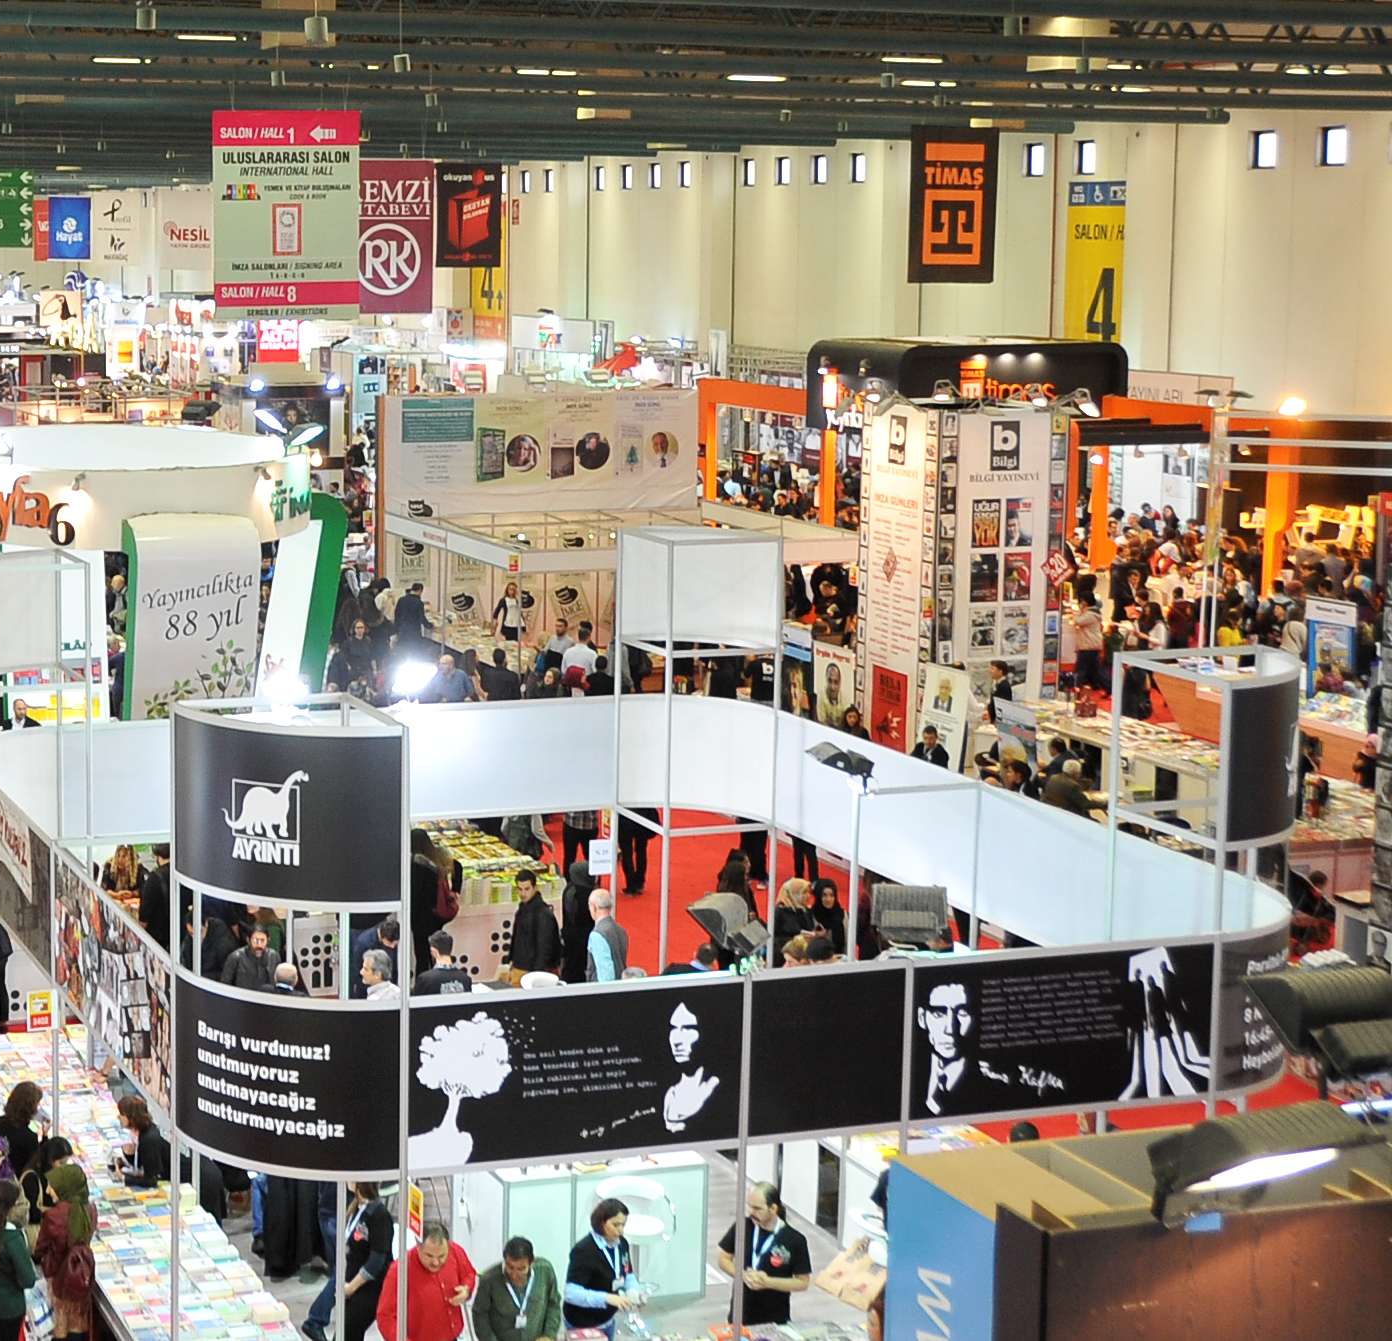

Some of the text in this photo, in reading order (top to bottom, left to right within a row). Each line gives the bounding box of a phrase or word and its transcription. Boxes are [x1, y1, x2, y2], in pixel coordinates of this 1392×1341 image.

[220, 127, 253, 139] SALON
[260, 127, 285, 139] HALL
[287, 127, 295, 144] 1
[222, 151, 350, 164] ULUSLARARASI SALON
[239, 165, 334, 177] INTERNATIONAL HALL
[359, 176, 431, 203] EMZİ
[925, 162, 984, 190] TİMAŞ
[169, 225, 210, 241] NESİL
[1074, 223, 1107, 240] SALON
[221, 286, 254, 298] SALON
[261, 286, 285, 298] HALL
[287, 286, 296, 303] 8
[1086, 268, 1116, 341] 4
[993, 424, 1017, 451] b
[993, 455, 1017, 470] Bilgi
[969, 471, 1040, 483] BİLGİ YAYINEVİ
[974, 501, 1000, 511] UĞUR
[141, 571, 255, 613] Yayıncılıkta
[164, 594, 248, 641] 88 yıl
[232, 836, 301, 867] AYRINTI
[197, 1020, 331, 1061] Barışı vurdunuz!
[197, 1048, 300, 1084] unutmuyoruz
[197, 1073, 316, 1112] unutmayacağız
[197, 1097, 346, 1140] unutturmayacağız
